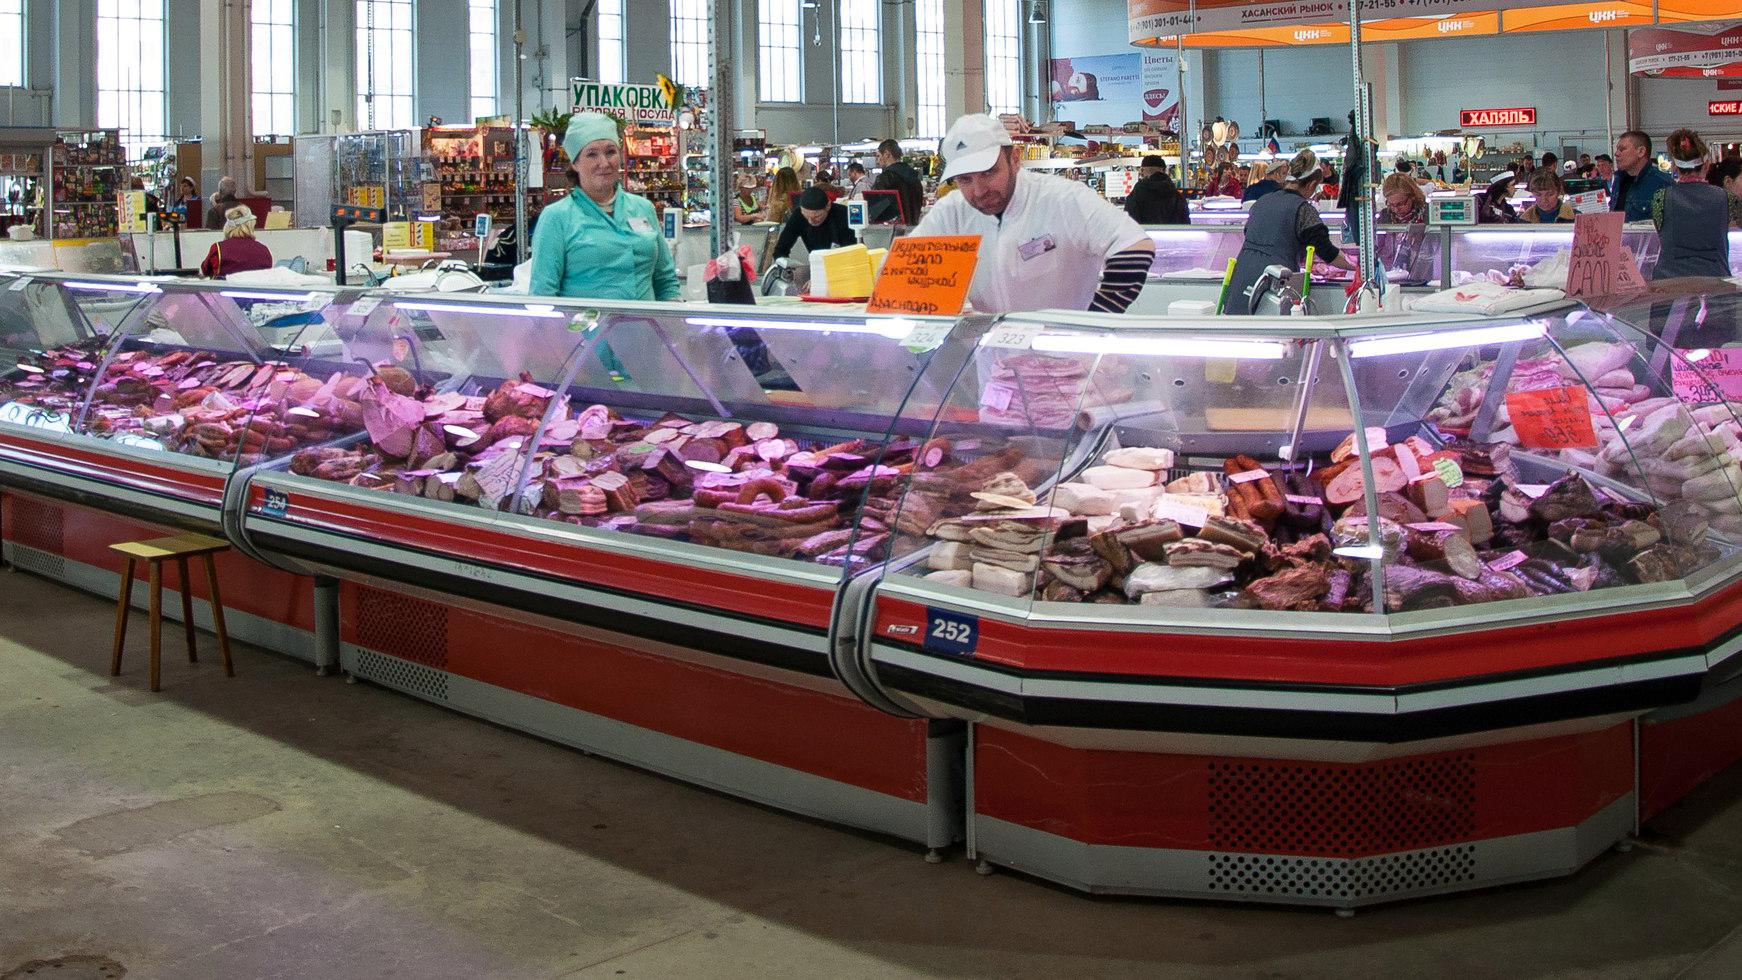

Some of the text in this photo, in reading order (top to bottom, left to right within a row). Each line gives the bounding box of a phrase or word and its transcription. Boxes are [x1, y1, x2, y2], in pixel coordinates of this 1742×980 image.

[1241, 3, 1298, 19] ХАСАНСКИЙ
[1300, 1, 1333, 14] РЫНОК
[573, 84, 668, 109] УПАКОВК
[1469, 111, 1529, 126] ХАЛЯЛЬ
[997, 333, 1025, 345] 323
[931, 618, 971, 644] 252
